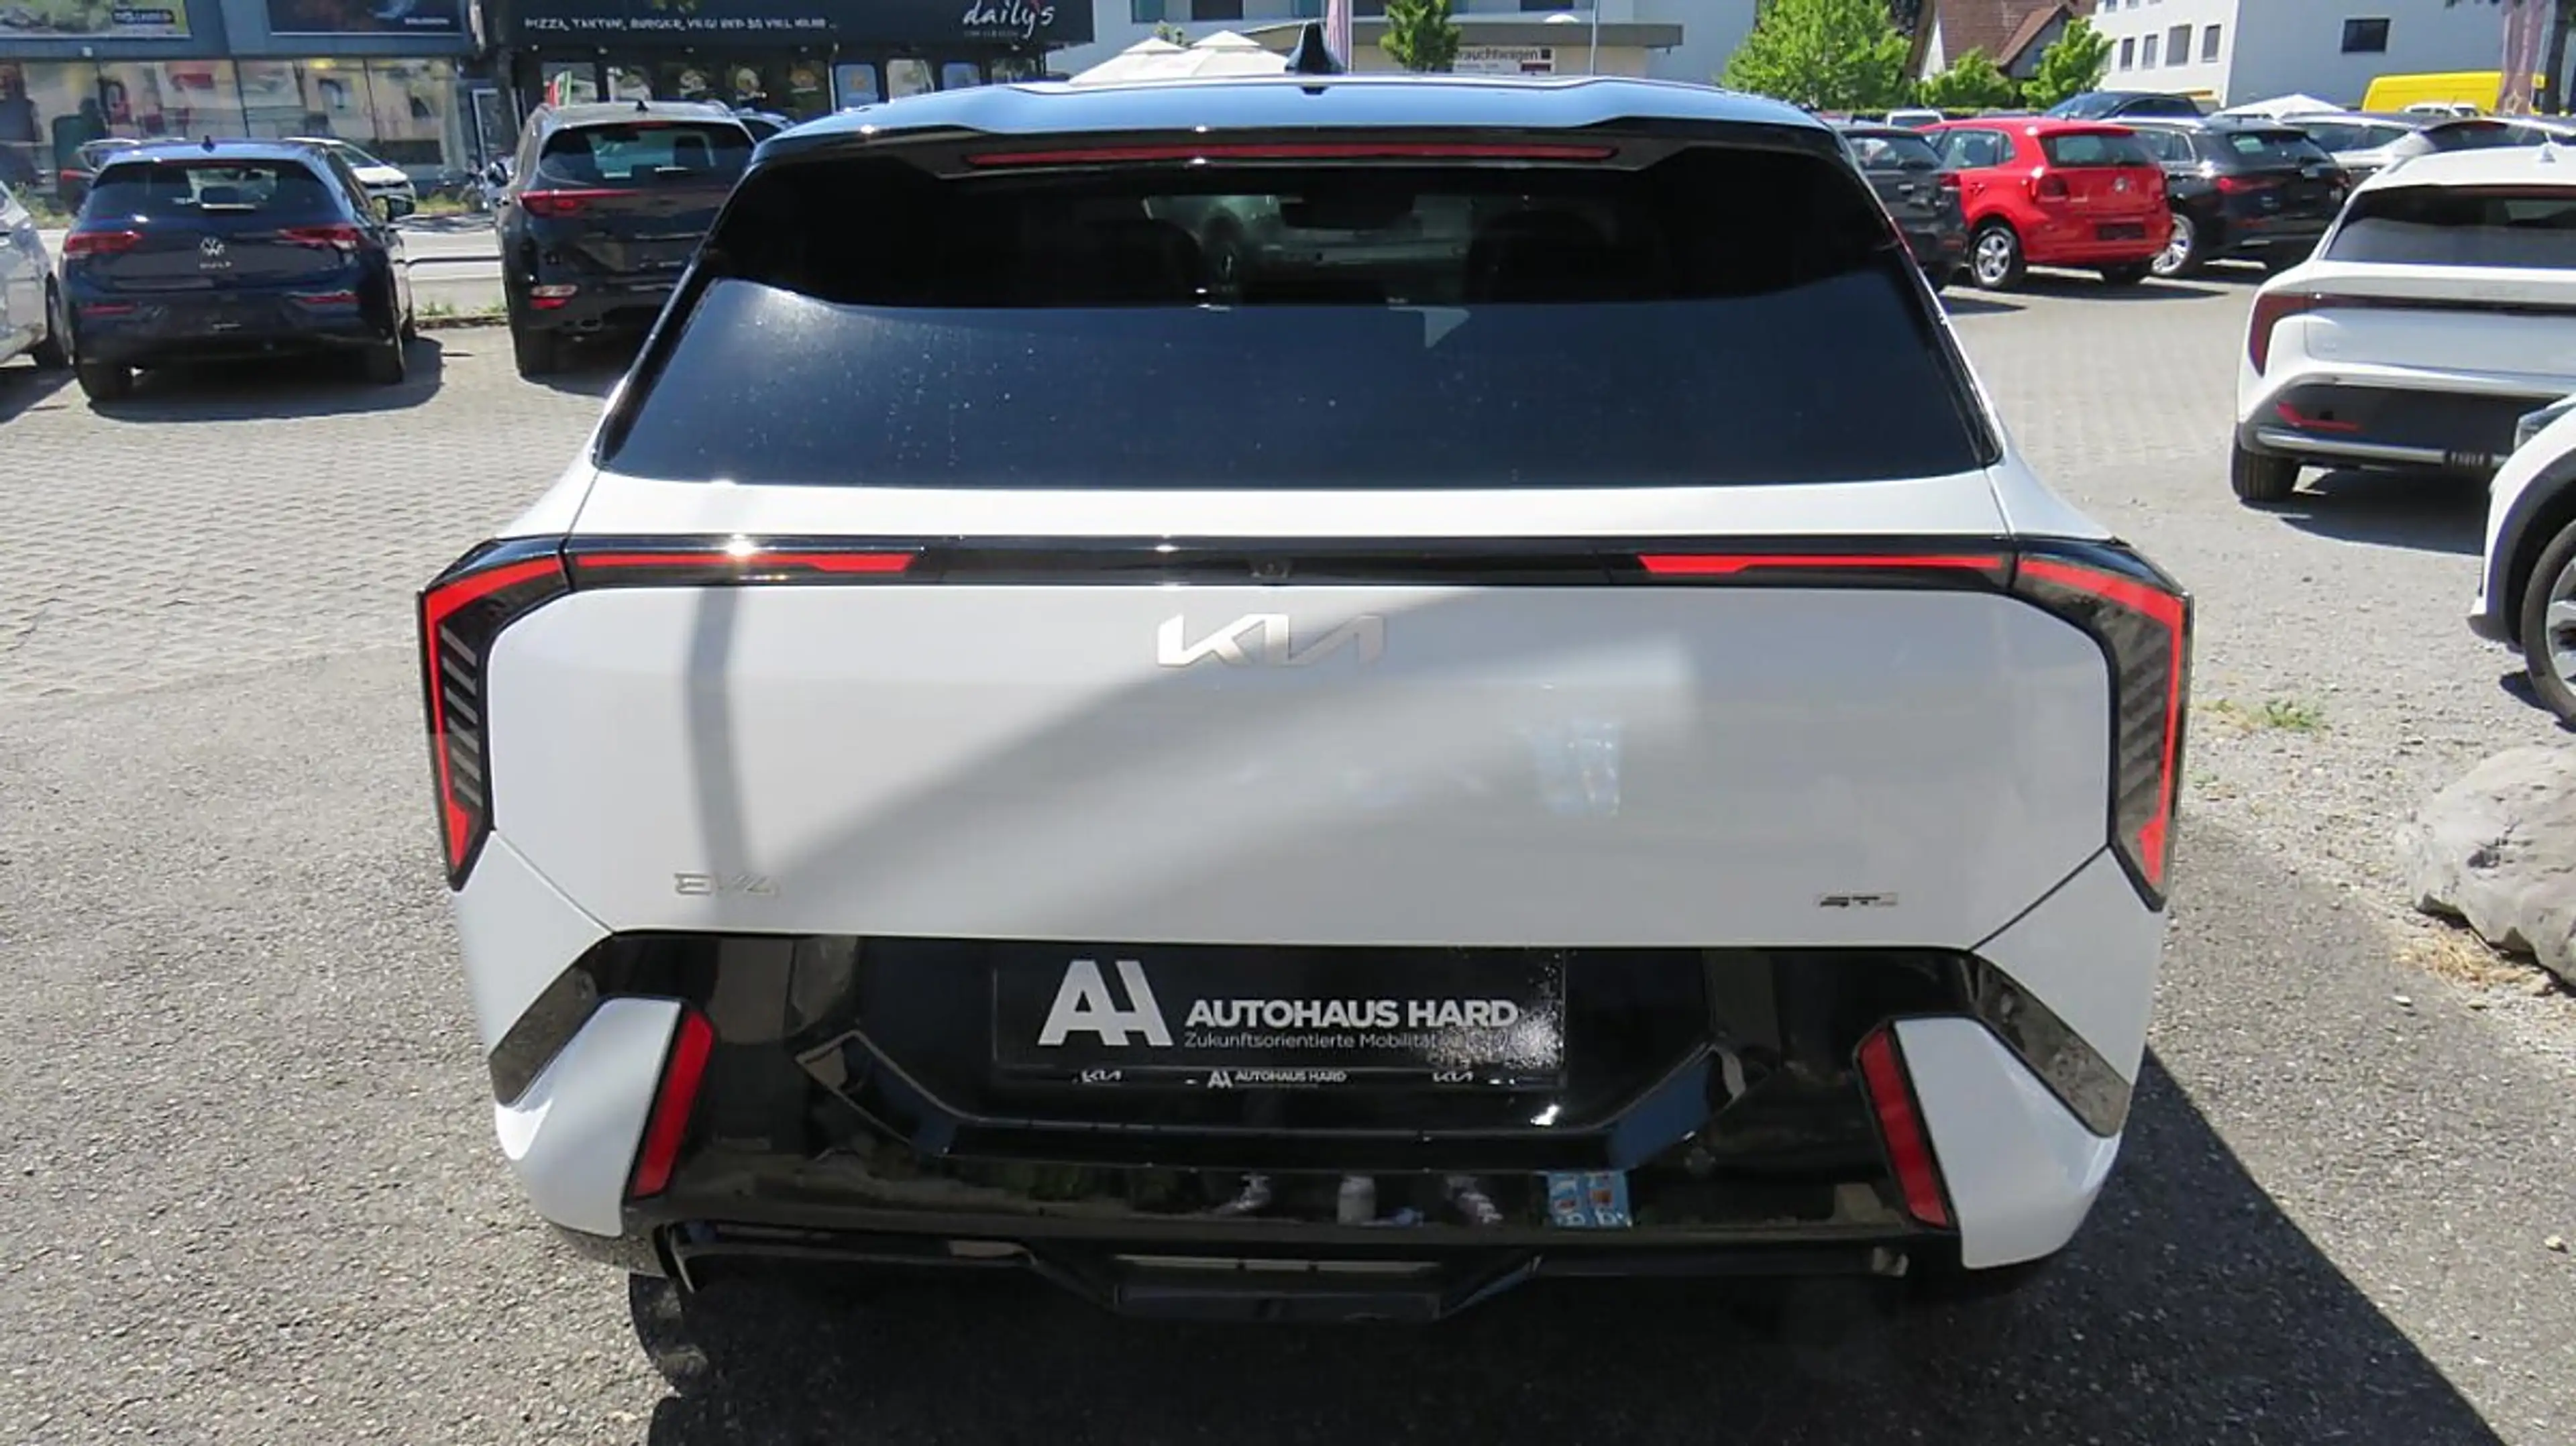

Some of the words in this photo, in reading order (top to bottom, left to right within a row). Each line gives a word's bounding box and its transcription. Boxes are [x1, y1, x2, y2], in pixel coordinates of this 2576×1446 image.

[524, 17, 570, 31] PIZZA,
[1457, 47, 1538, 62] rauchtwagen
[1157, 612, 1387, 669] KIA
[1185, 999, 1399, 1028] AUTOHAUS
[1409, 999, 1520, 1028] HARD
[1184, 1032, 1355, 1049] Zukunftsorientierte
[1235, 1071, 1306, 1082] AUTOHAUS
[1309, 1071, 1347, 1083] HARD
